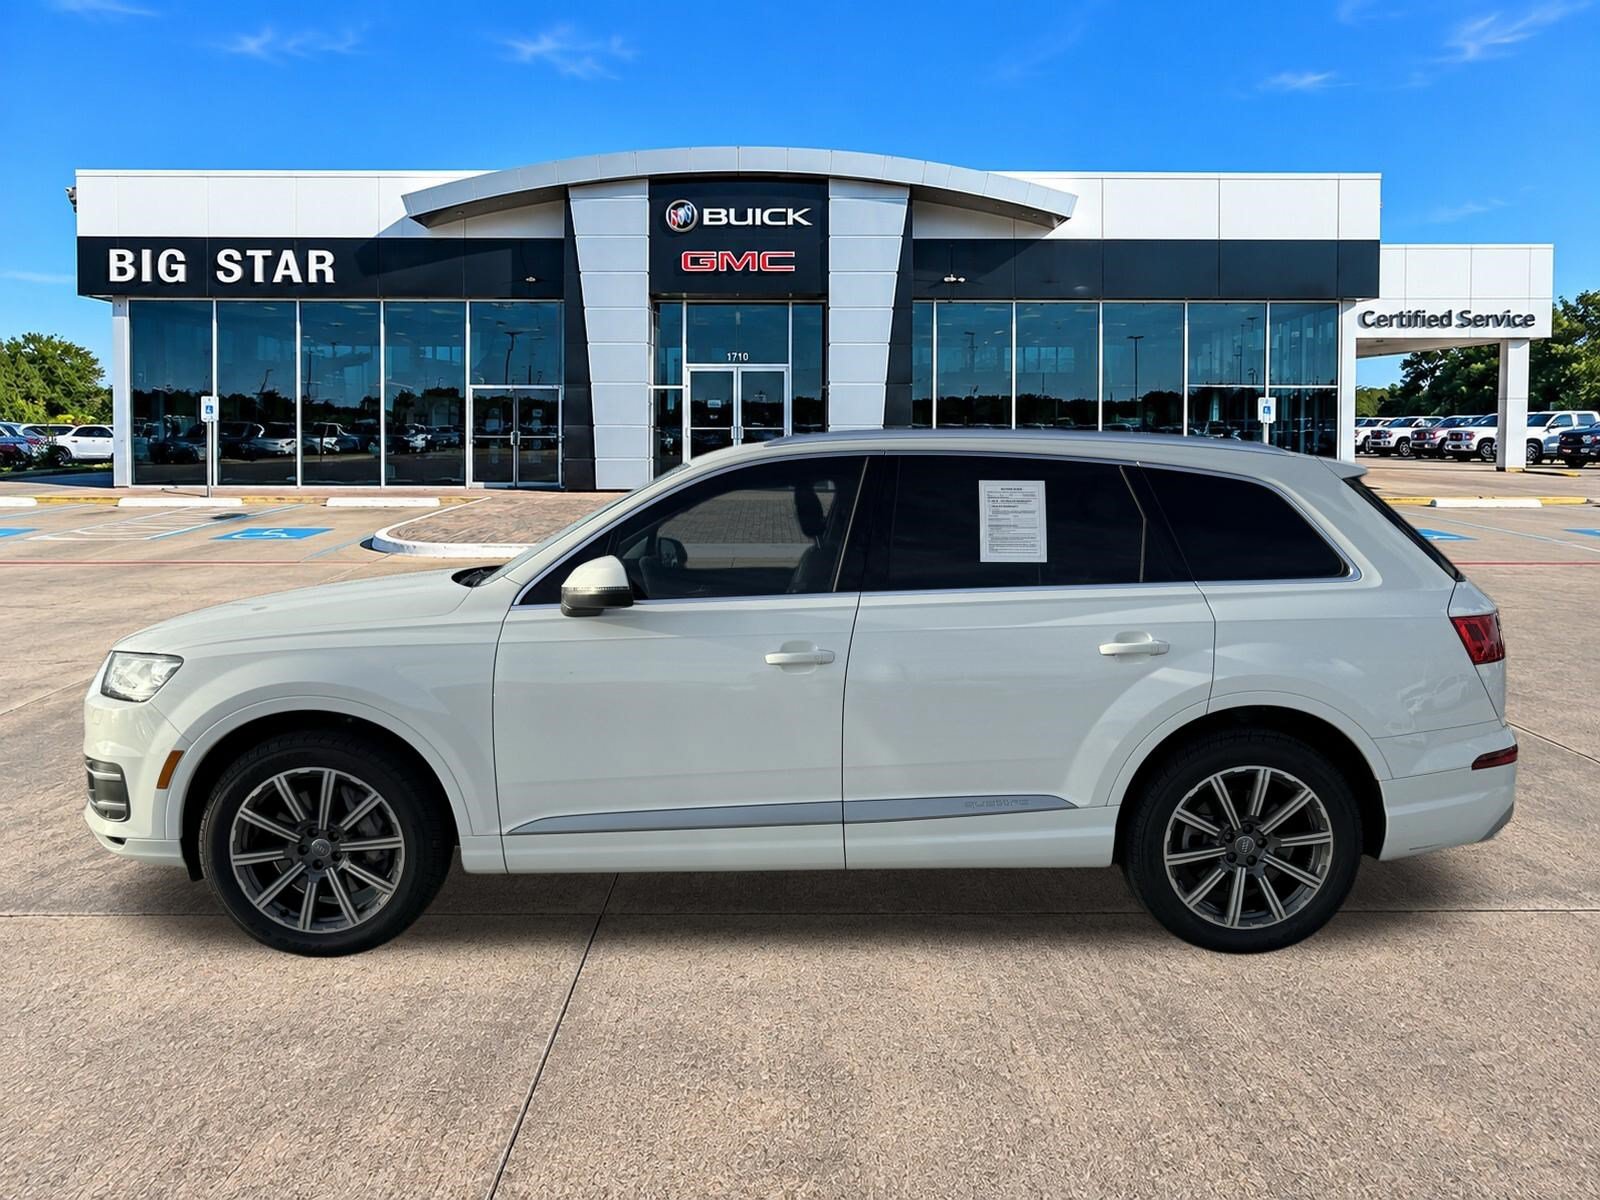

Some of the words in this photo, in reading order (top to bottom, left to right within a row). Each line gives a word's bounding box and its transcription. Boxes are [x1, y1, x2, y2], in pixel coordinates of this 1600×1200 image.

[702, 208, 813, 226] BUICK
[108, 249, 187, 283] BIG
[216, 249, 335, 283] STAR
[681, 251, 796, 272] GMC
[1361, 309, 1452, 328] Certified
[1457, 309, 1536, 328] Service
[726, 352, 749, 361] 1710
